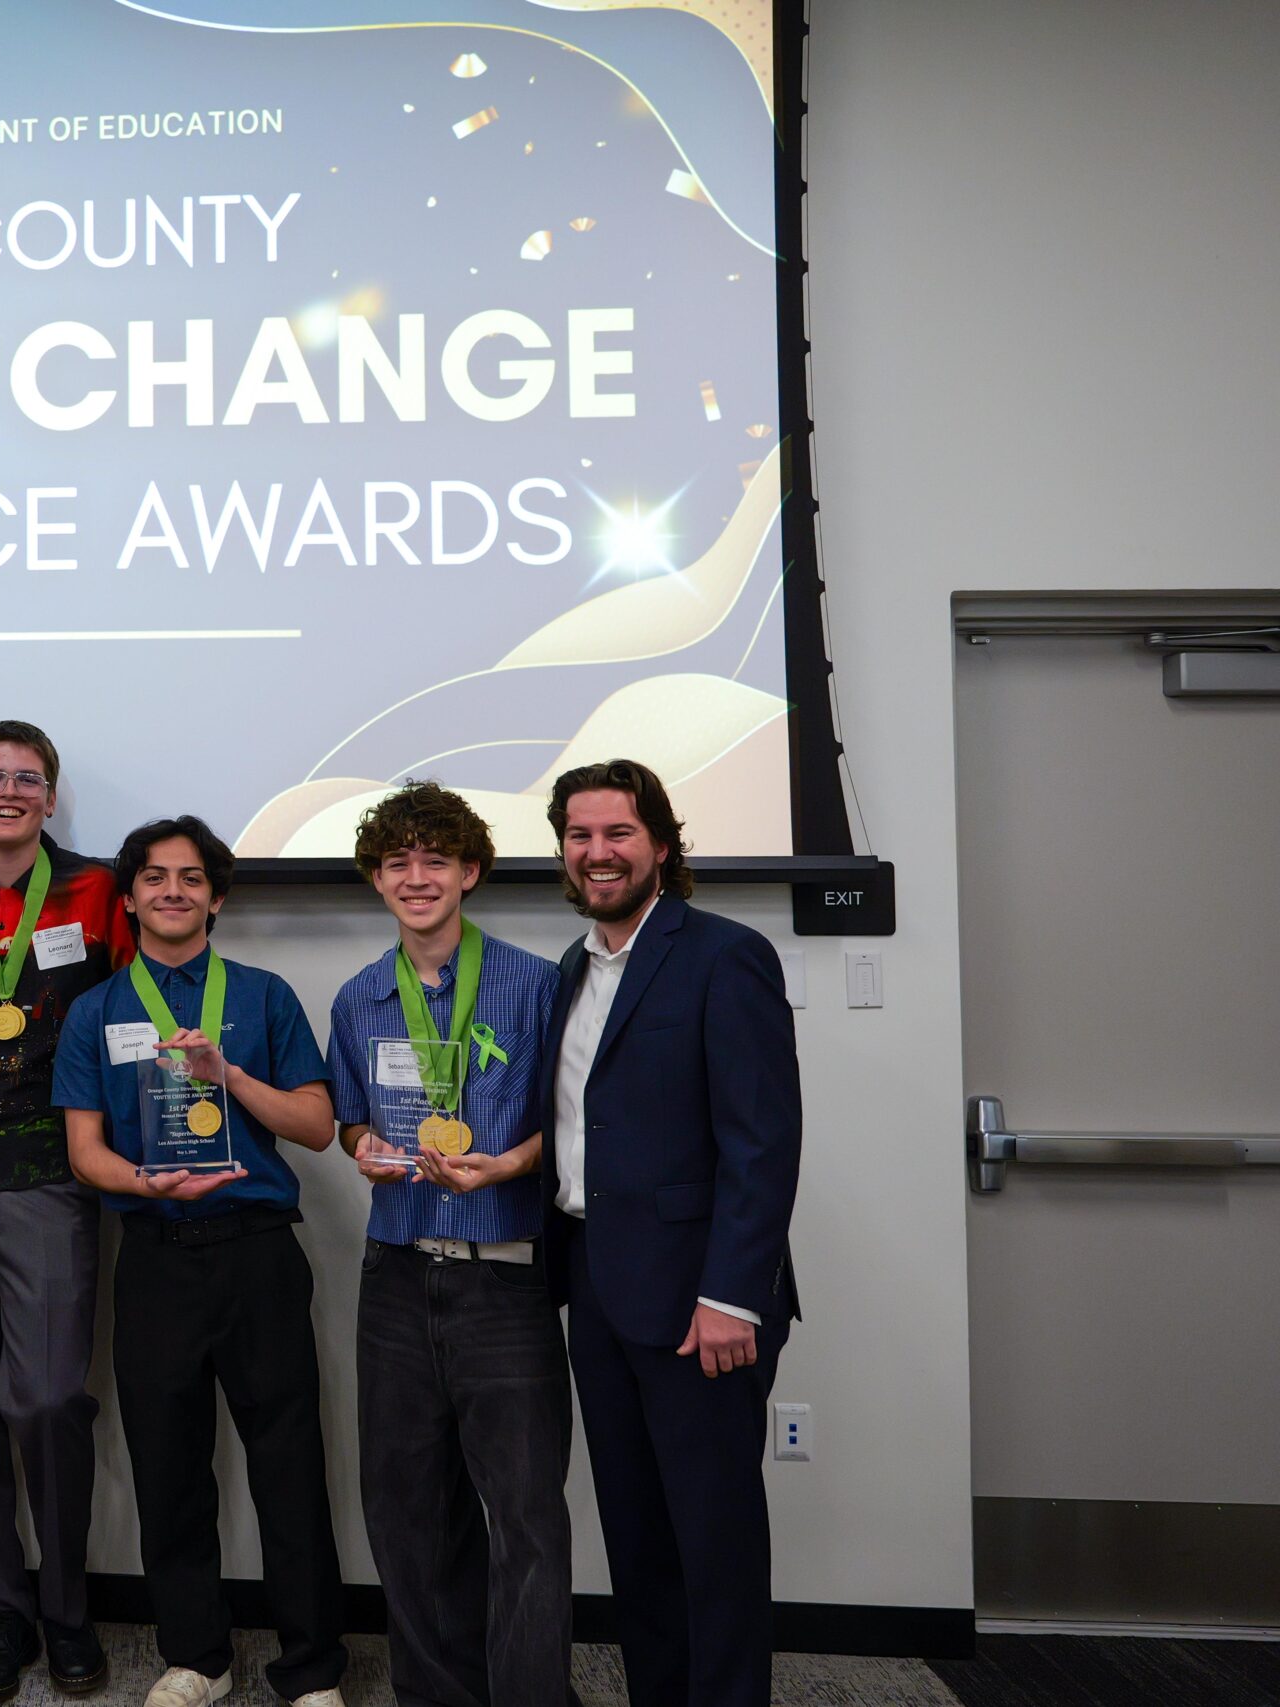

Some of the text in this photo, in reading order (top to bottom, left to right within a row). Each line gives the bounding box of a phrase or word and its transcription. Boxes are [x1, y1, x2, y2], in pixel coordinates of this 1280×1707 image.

[49, 117, 89, 141] OF
[99, 108, 283, 140] EDUCATION
[10, 308, 636, 431] CHANGE
[116, 477, 573, 574] AWARDS
[824, 891, 864, 906] EXIT
[48, 943, 73, 953] Leonard
[121, 1041, 144, 1049] Joseph
[180, 1104, 191, 1112] Pla
